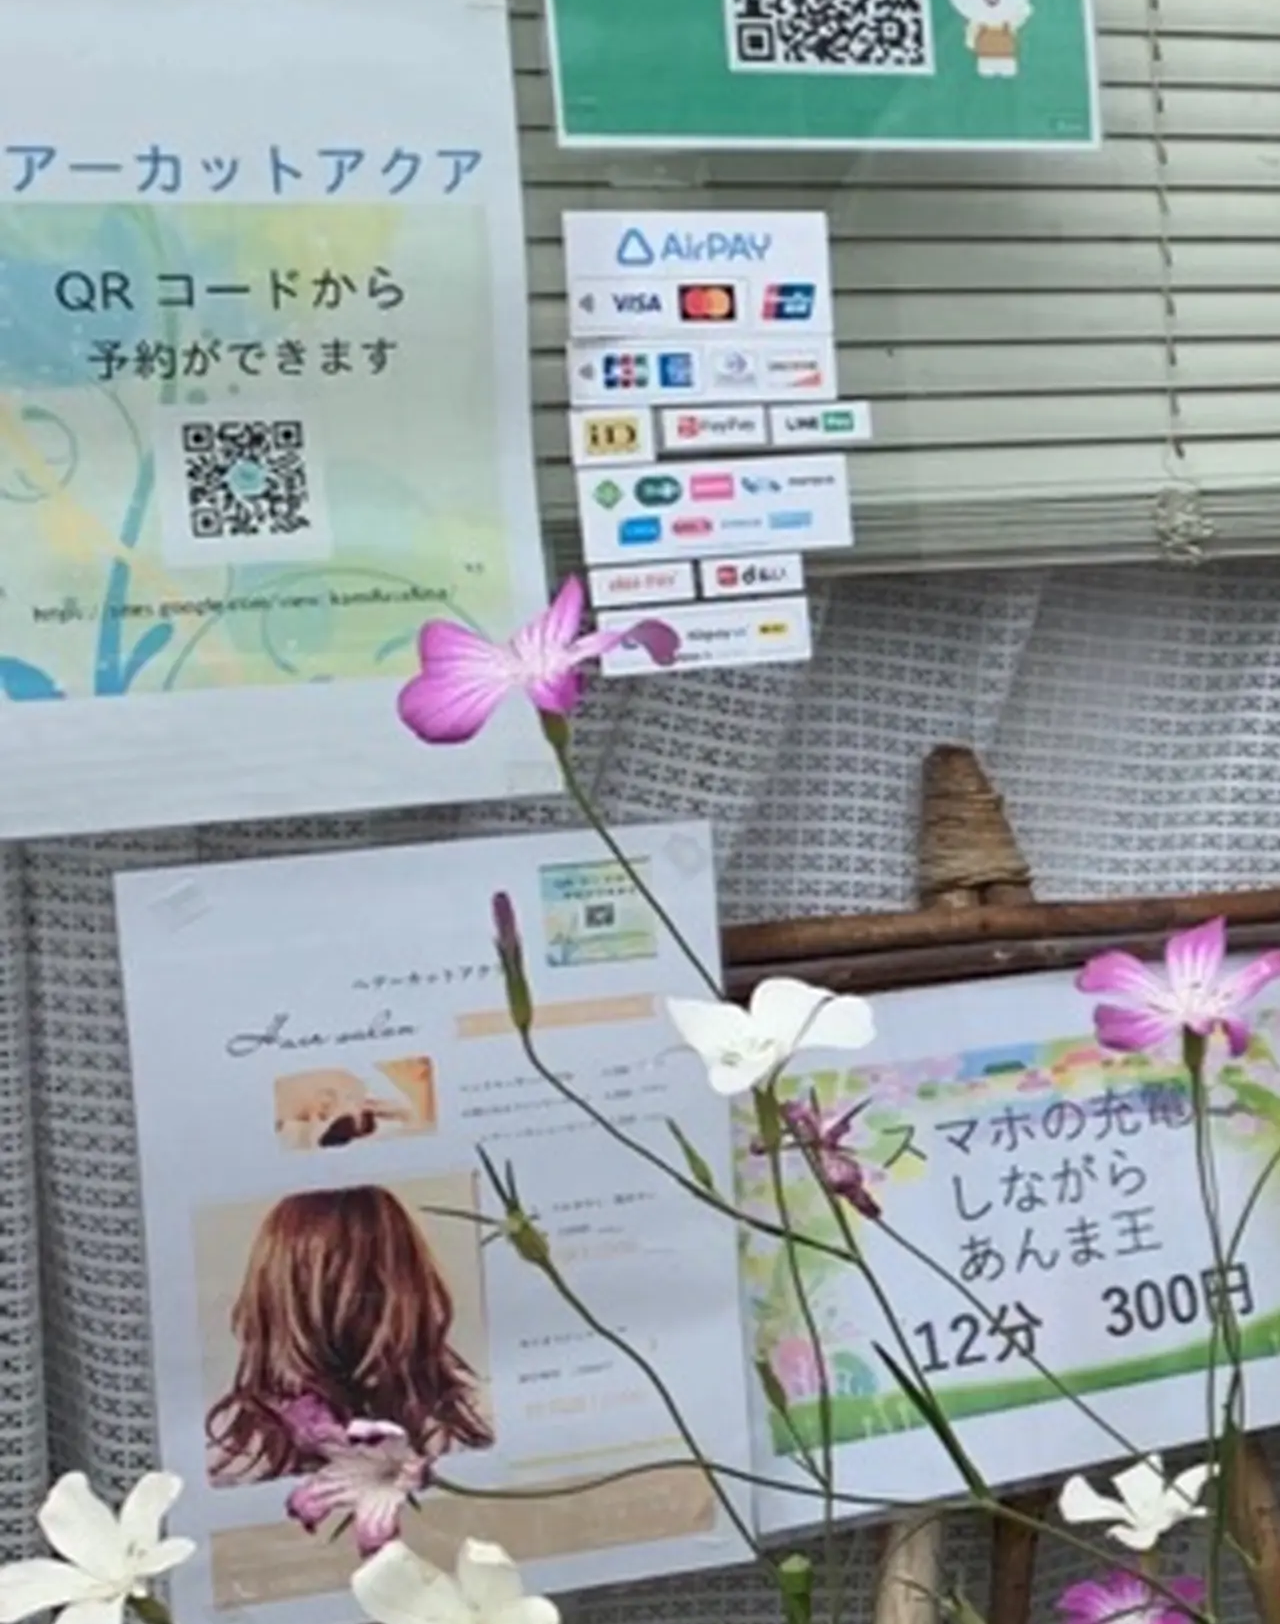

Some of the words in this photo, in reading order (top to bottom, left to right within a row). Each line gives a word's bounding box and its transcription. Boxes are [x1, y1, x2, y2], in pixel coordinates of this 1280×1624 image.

[4, 144, 483, 194] アーカットアクア
[661, 232, 772, 262] AirPAY
[55, 272, 134, 313] QR
[157, 266, 406, 311] コードから
[612, 293, 662, 313] VISA
[87, 336, 399, 381] 予約ができます
[351, 964, 505, 989] ヘアーカットアク
[880, 1084, 1198, 1170] スマホの充電
[953, 1149, 1149, 1221] しながら
[959, 1207, 1163, 1283] あんま王
[914, 1301, 1042, 1373] 12分
[1101, 1262, 1253, 1336] 300円
